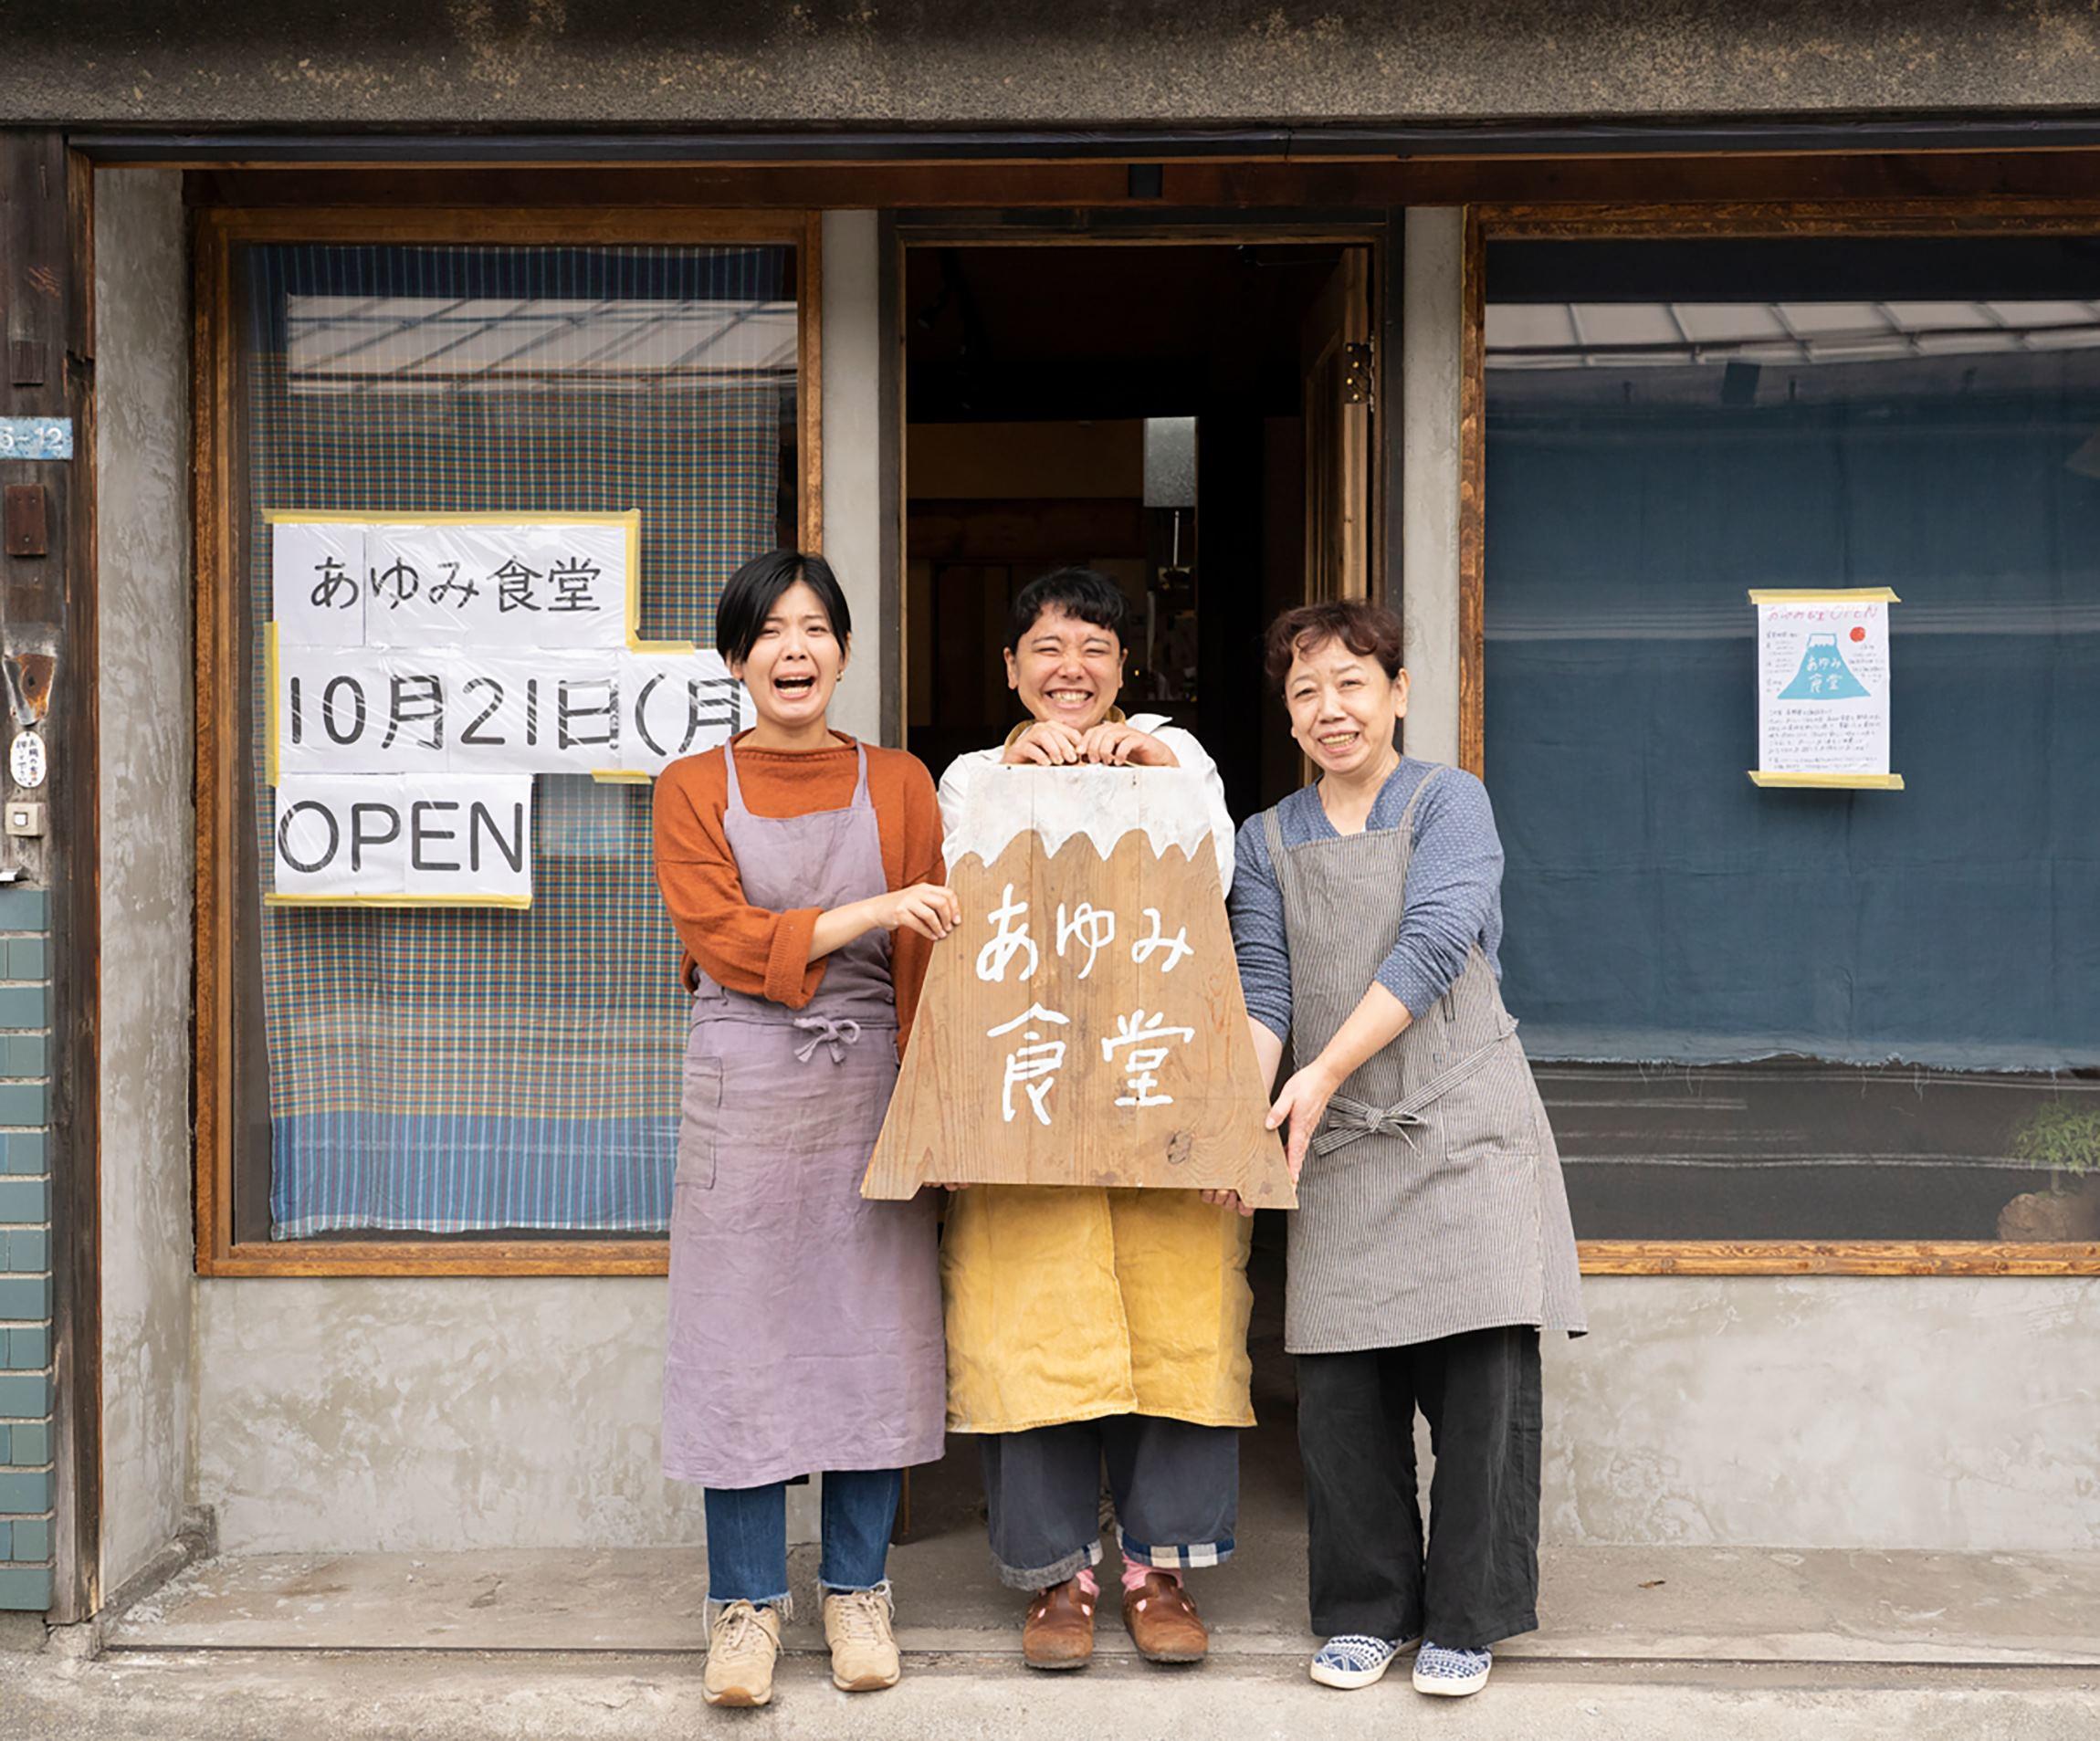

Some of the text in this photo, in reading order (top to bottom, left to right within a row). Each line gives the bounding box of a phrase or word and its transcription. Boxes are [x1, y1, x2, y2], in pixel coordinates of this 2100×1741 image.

[310, 555, 601, 614] あゆみ食堂
[278, 800, 524, 874] OPEN
[975, 882, 1195, 982] あゆみ
[986, 1002, 1196, 1126] 食堂
